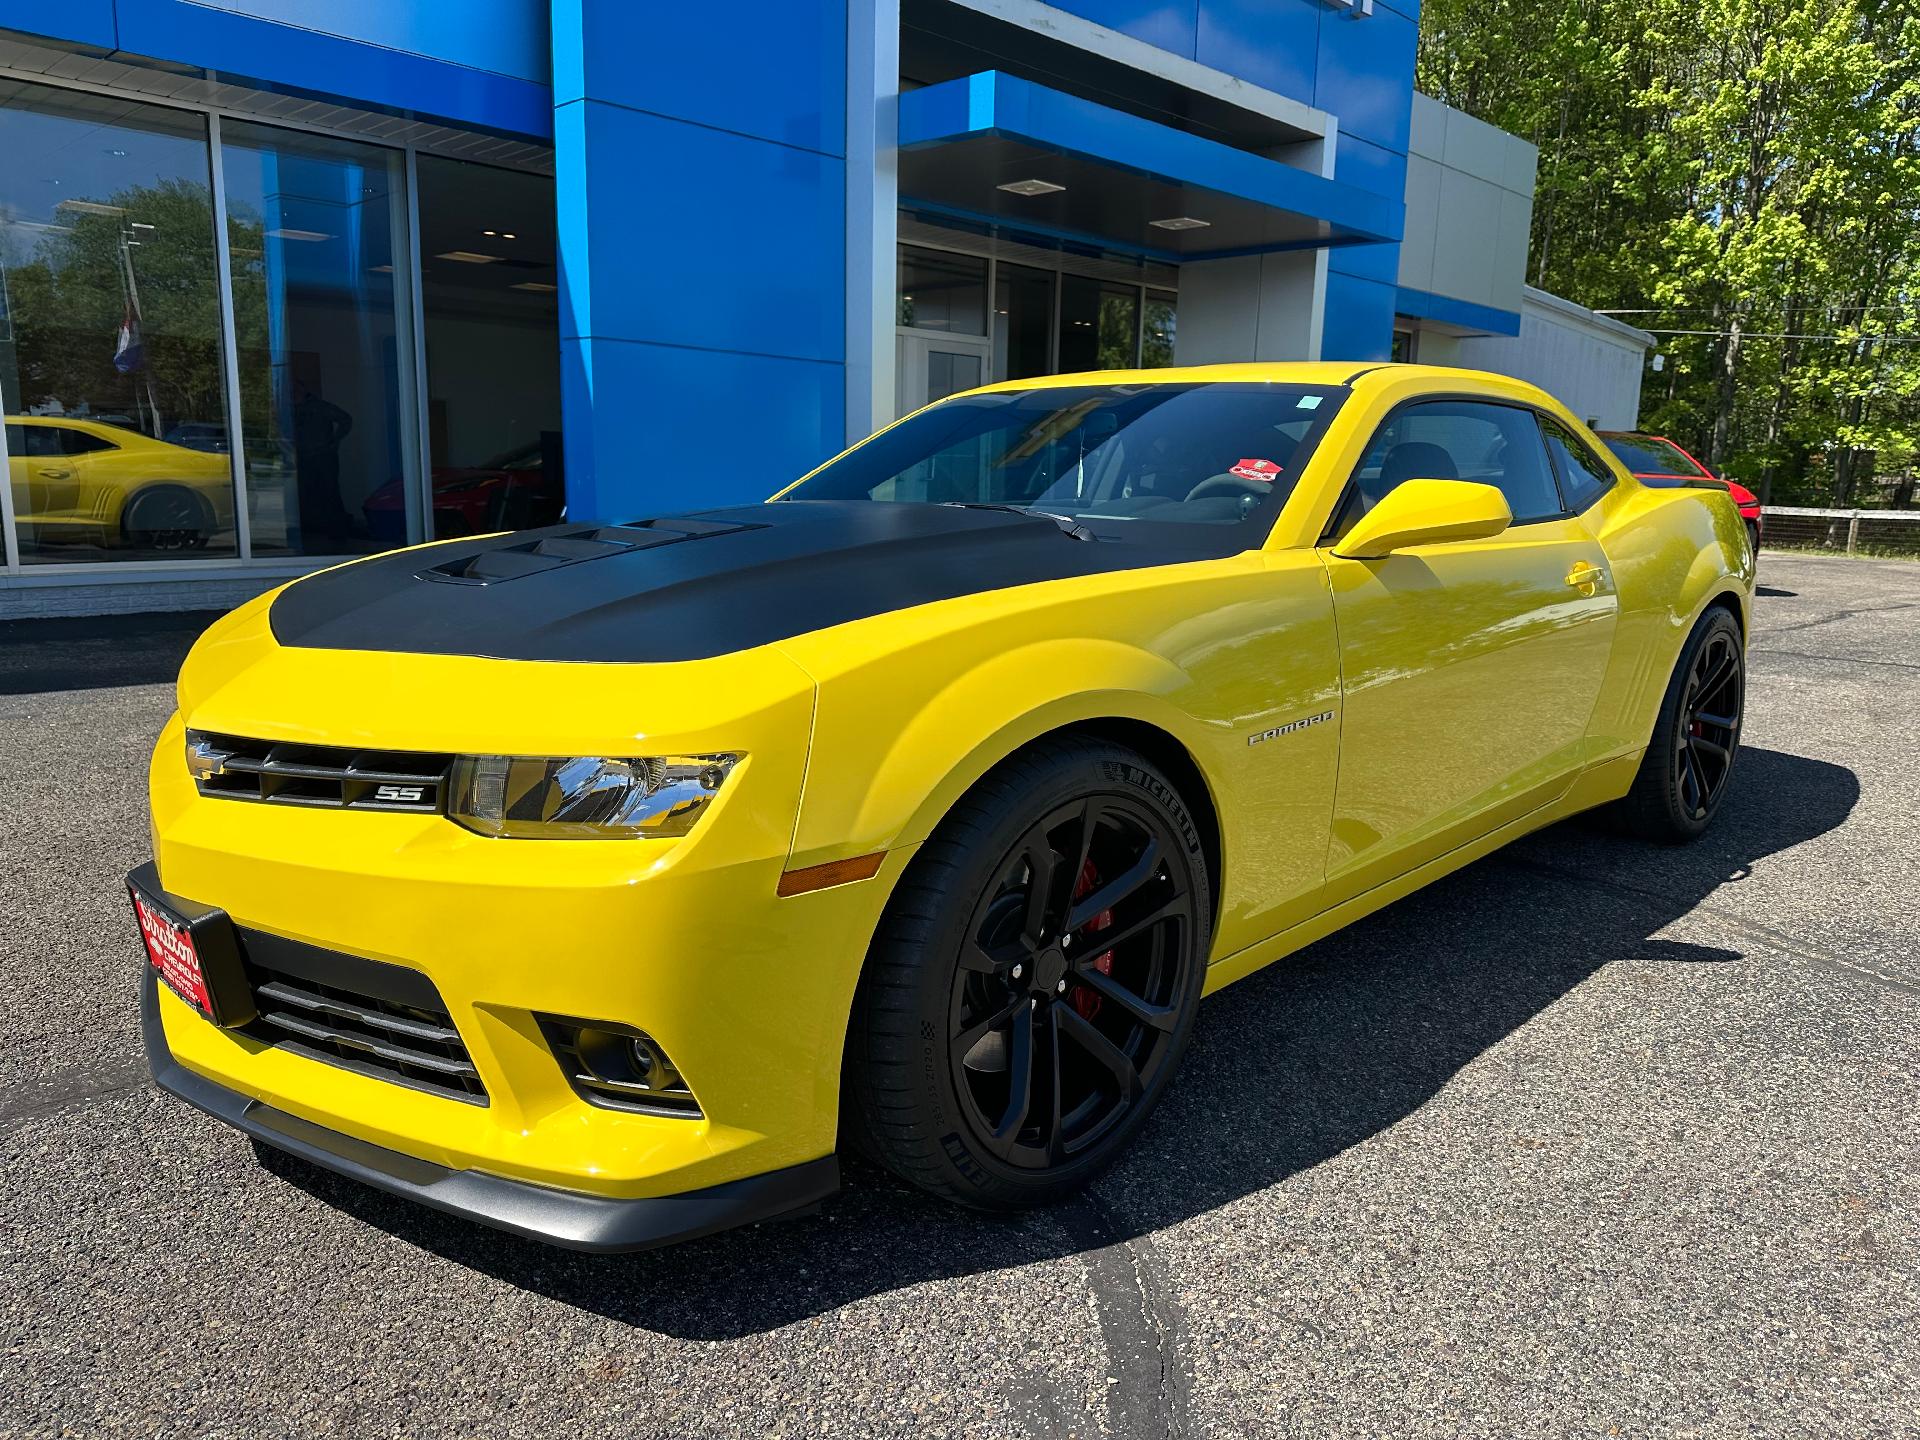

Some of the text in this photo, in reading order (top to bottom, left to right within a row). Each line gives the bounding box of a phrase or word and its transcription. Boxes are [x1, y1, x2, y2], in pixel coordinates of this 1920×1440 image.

[1247, 709, 1336, 747] CAMARO
[375, 785, 424, 800] SS
[1128, 767, 1198, 848] MICHELIN
[140, 901, 199, 970] Stratton
[164, 950, 202, 986] CHEVROLET
